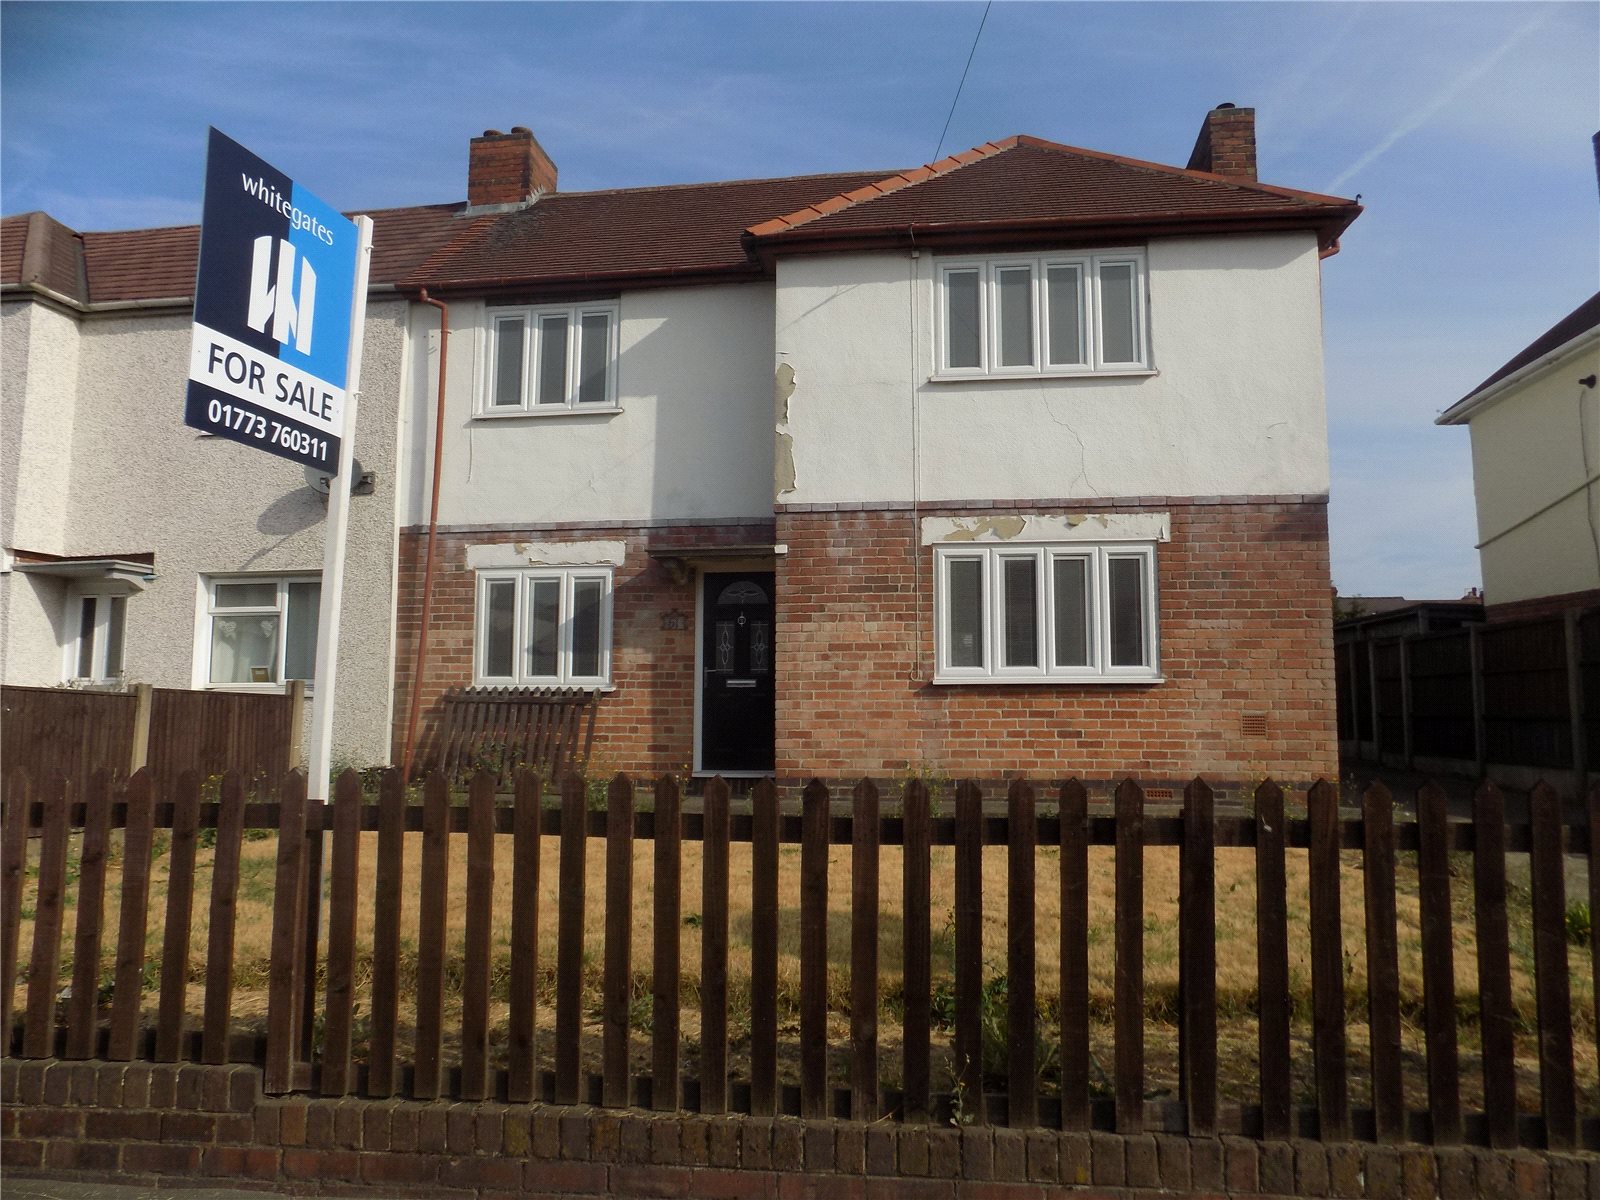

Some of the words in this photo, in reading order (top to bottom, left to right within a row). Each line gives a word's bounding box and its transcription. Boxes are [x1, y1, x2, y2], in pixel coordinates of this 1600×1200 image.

[241, 172, 334, 246] whitegates
[208, 342, 265, 395] FOR
[275, 372, 334, 423] SALE
[208, 399, 267, 439] 01773
[270, 420, 328, 462] 760311
